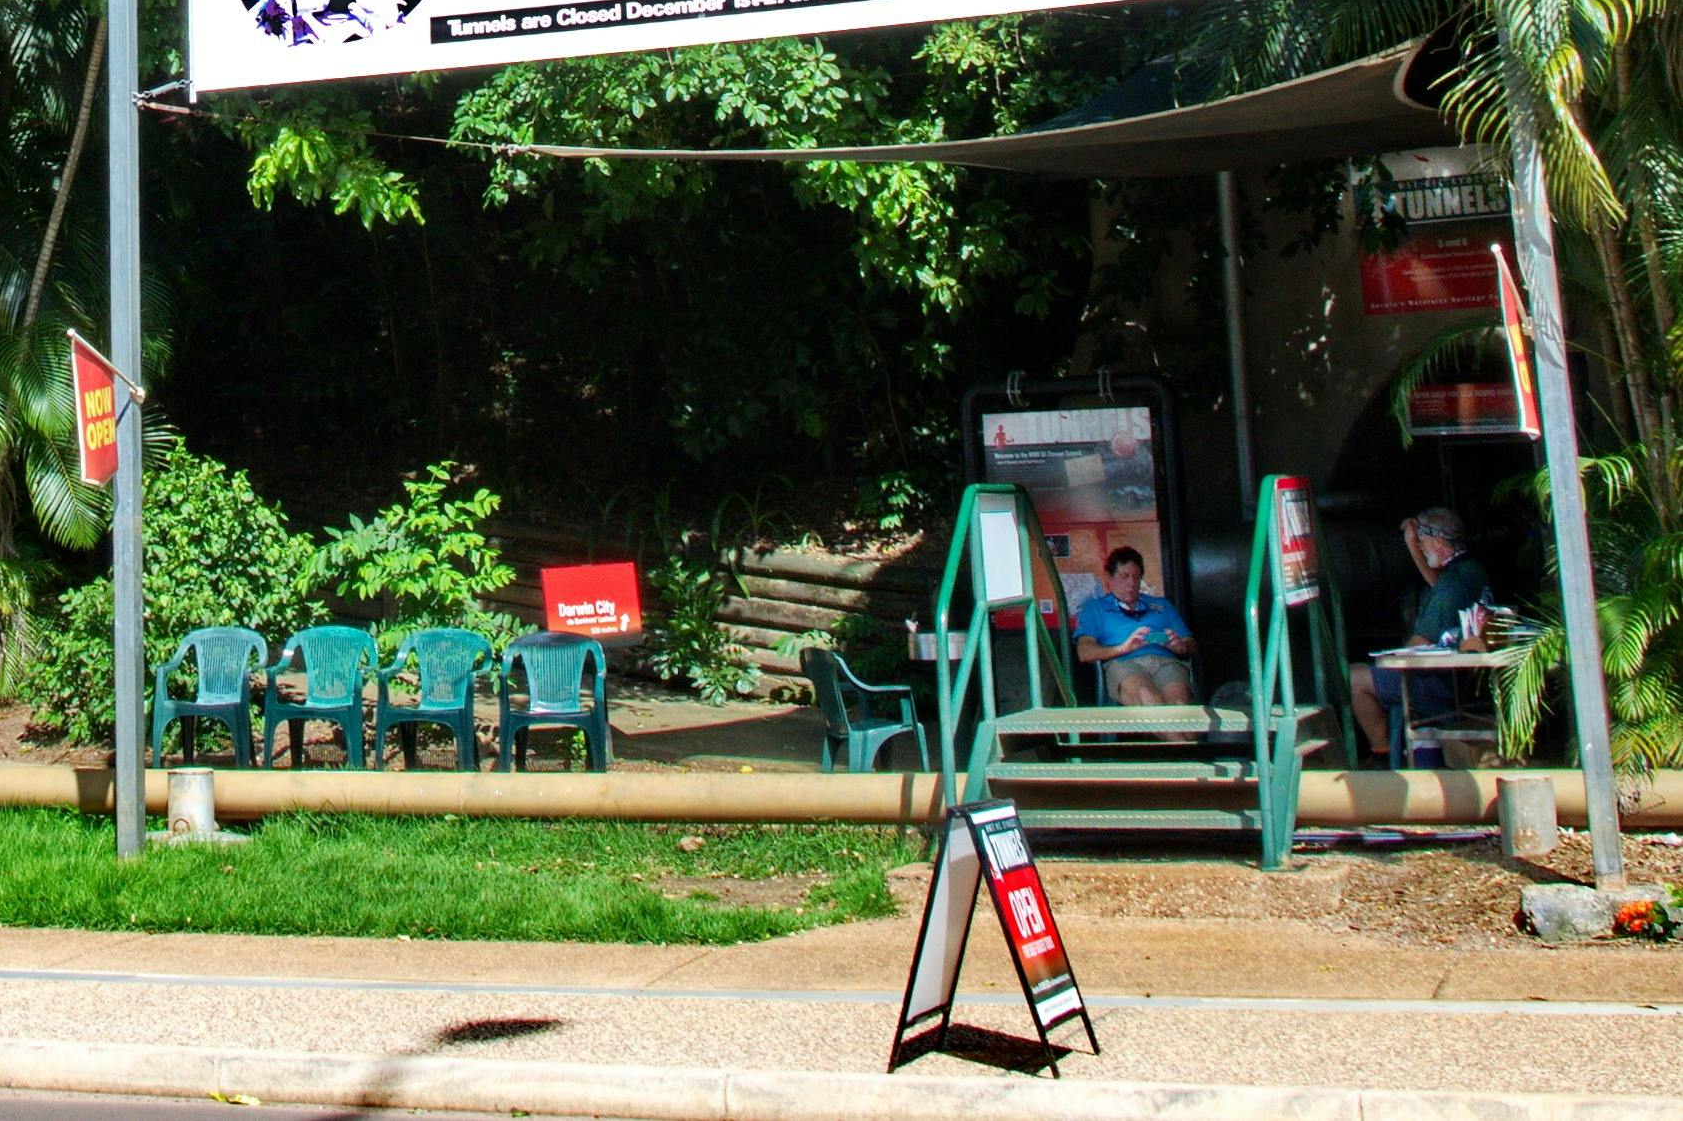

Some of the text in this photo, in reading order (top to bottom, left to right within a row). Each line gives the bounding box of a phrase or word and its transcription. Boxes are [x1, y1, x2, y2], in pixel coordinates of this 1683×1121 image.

[446, 13, 517, 38] Tunnels
[521, 13, 552, 30] are
[556, 2, 622, 27] Closed
[84, 385, 113, 419] NOW
[86, 416, 117, 452] OPEN
[558, 599, 616, 617] Darwin City
[1008, 886, 1046, 939] OPEN
